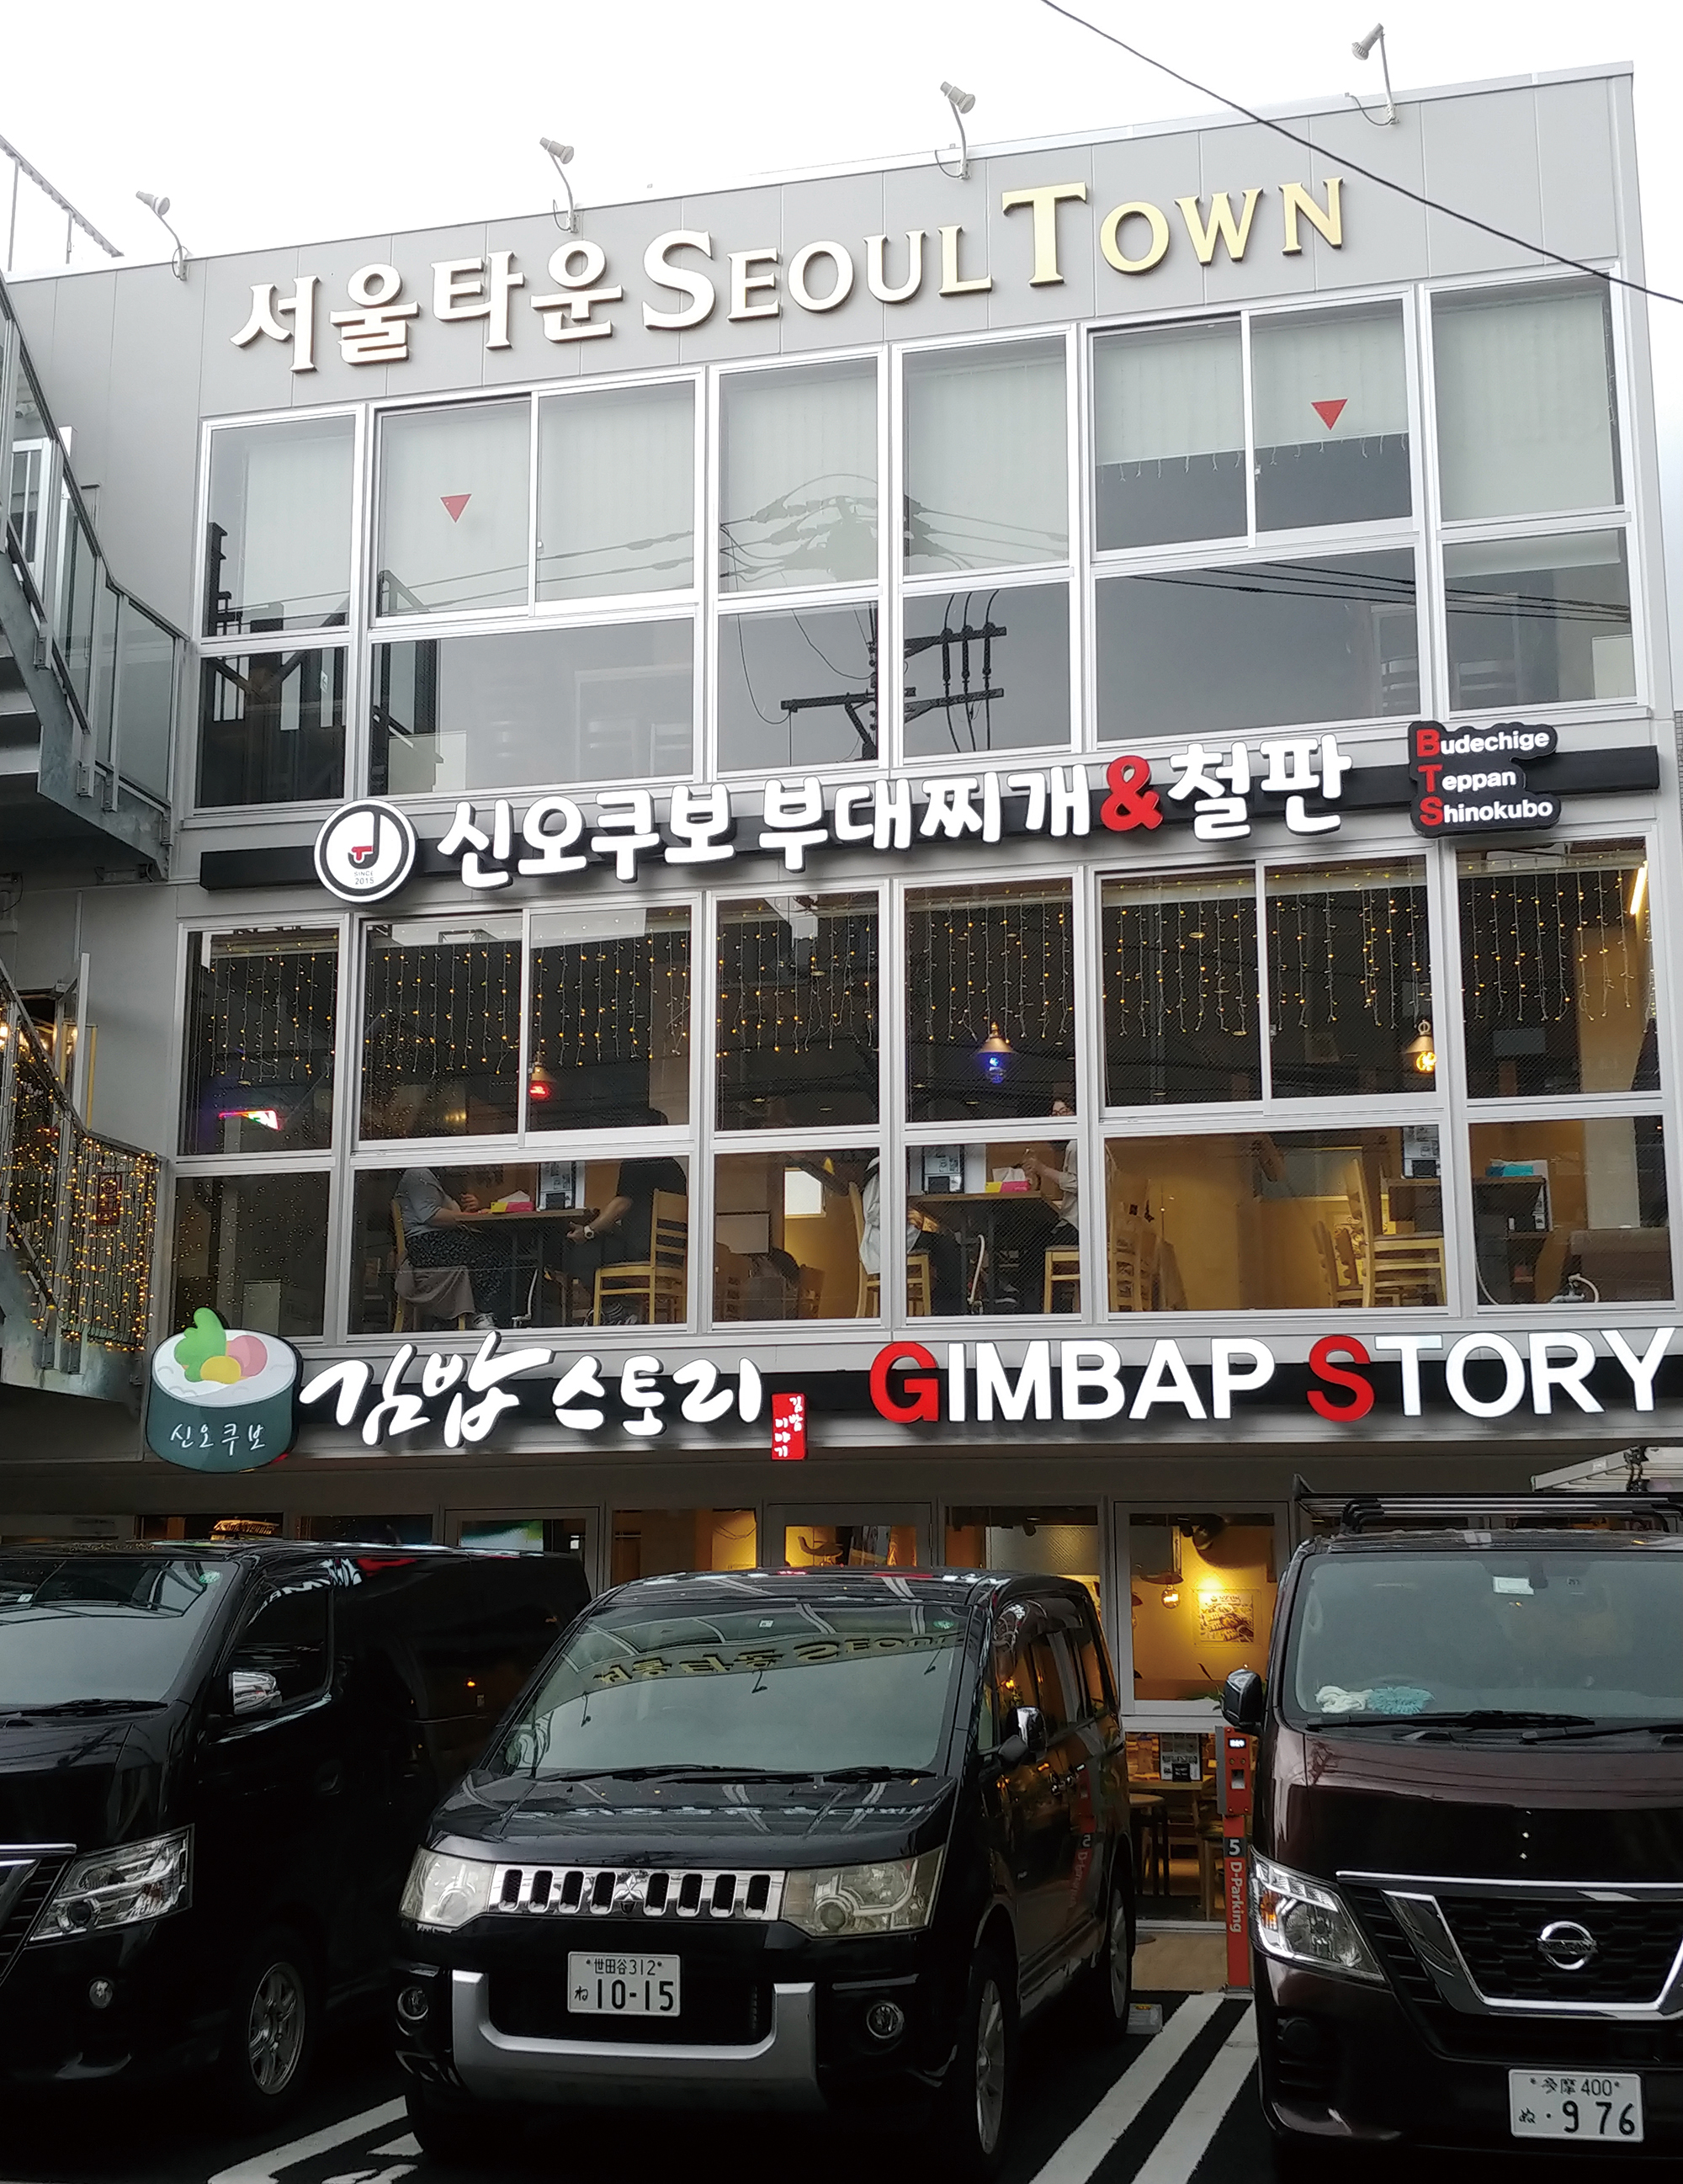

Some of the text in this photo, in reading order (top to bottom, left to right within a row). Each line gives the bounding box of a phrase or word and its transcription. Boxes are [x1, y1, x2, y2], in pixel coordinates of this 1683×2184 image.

[230, 177, 1345, 373] 서울타운 SEOUL TOWN
[1416, 729, 1550, 757] Budechige
[1417, 764, 1516, 792] Teppan
[1419, 795, 1553, 826] Shinokubo
[437, 784, 735, 890] 신오쿠보
[354, 877, 374, 885] 2015
[300, 1331, 763, 1448] 김밥 스토리
[869, 1326, 1676, 1424] GIMBAP STORY
[170, 1423, 266, 1457] 신오쿠보
[1228, 1837, 1241, 1857] 5
[1229, 1861, 1245, 1934] D-Parking
[574, 1978, 674, 2011] ね 10-15
[1518, 2107, 1537, 2124] ぬ
